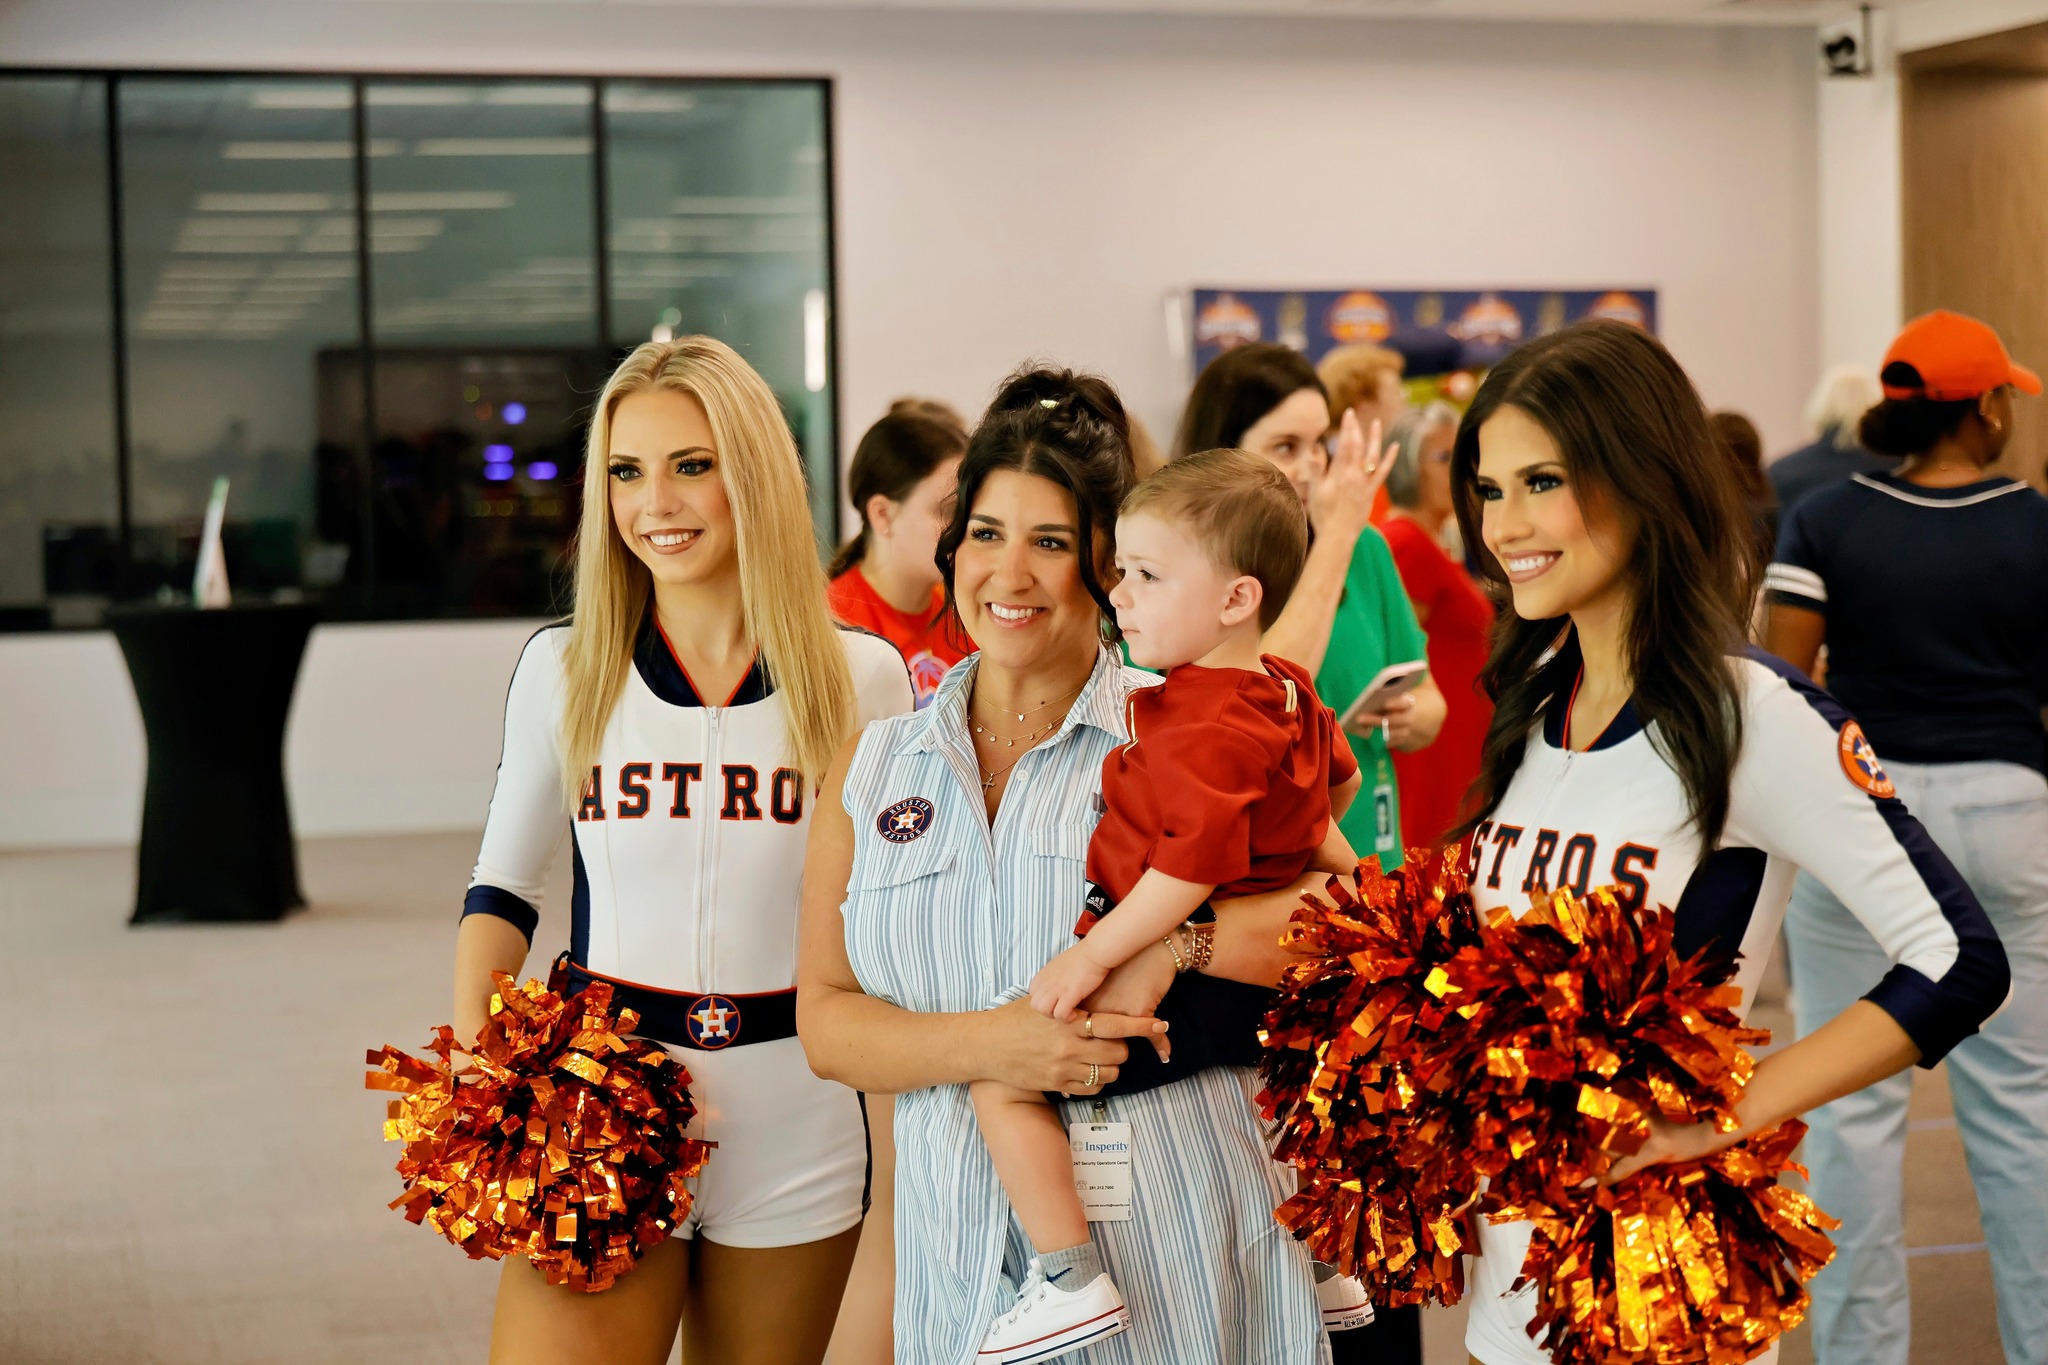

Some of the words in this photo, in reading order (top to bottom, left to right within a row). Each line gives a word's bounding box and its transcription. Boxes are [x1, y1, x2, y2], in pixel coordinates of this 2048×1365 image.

[578, 762, 804, 824] ASTRO
[889, 800, 930, 814] HOUSTON
[895, 813, 917, 829] H
[884, 830, 921, 840] ASTROS
[1467, 821, 1659, 914] STROS
[698, 1008, 730, 1038] H
[1085, 1141, 1129, 1153] Insperity
